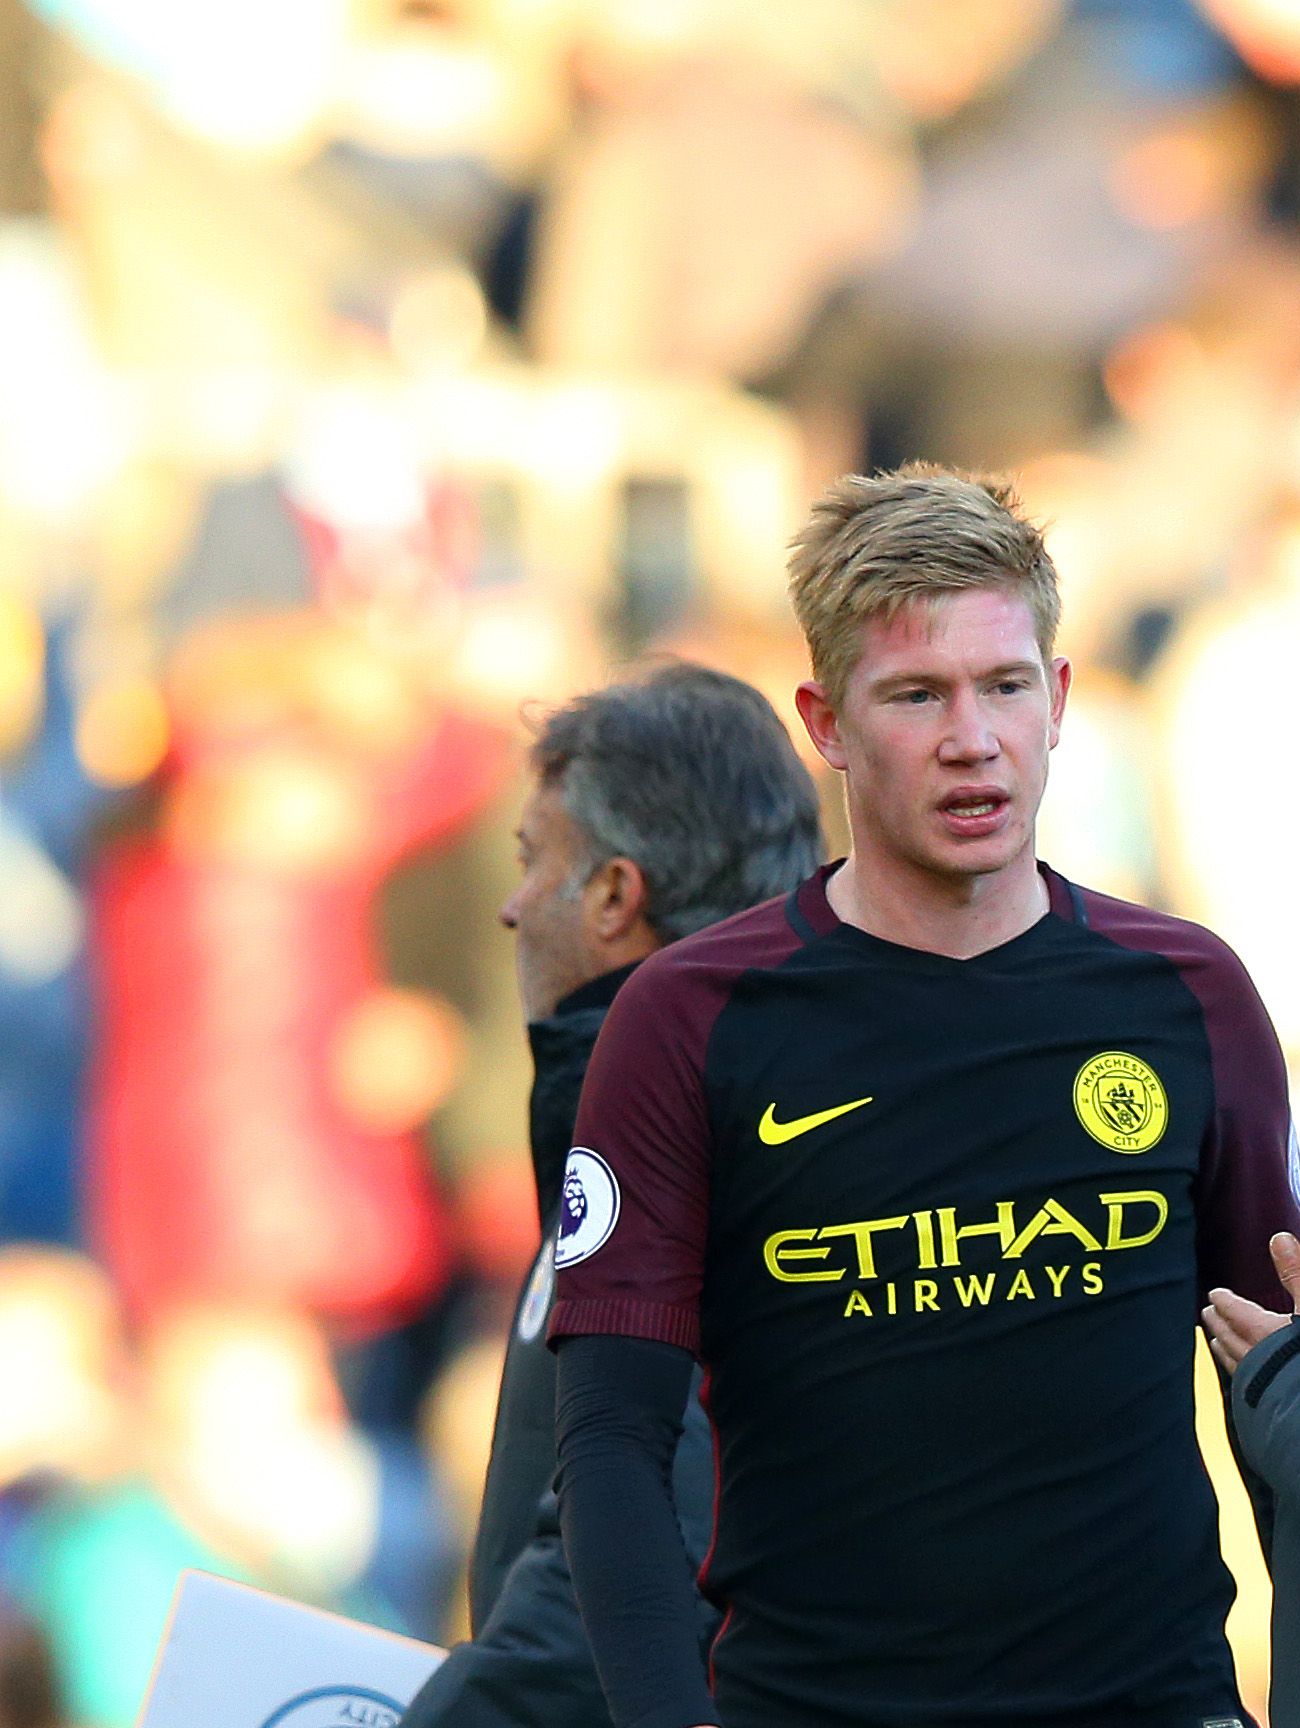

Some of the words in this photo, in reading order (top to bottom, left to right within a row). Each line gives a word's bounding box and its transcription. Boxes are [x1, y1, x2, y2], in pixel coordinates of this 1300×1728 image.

[1083, 1059, 1157, 1093] MANCHESTER
[1113, 1136, 1141, 1147] CITY
[763, 1190, 1169, 1282] ETIHAD
[844, 1262, 1104, 1318] AIRWAYS
